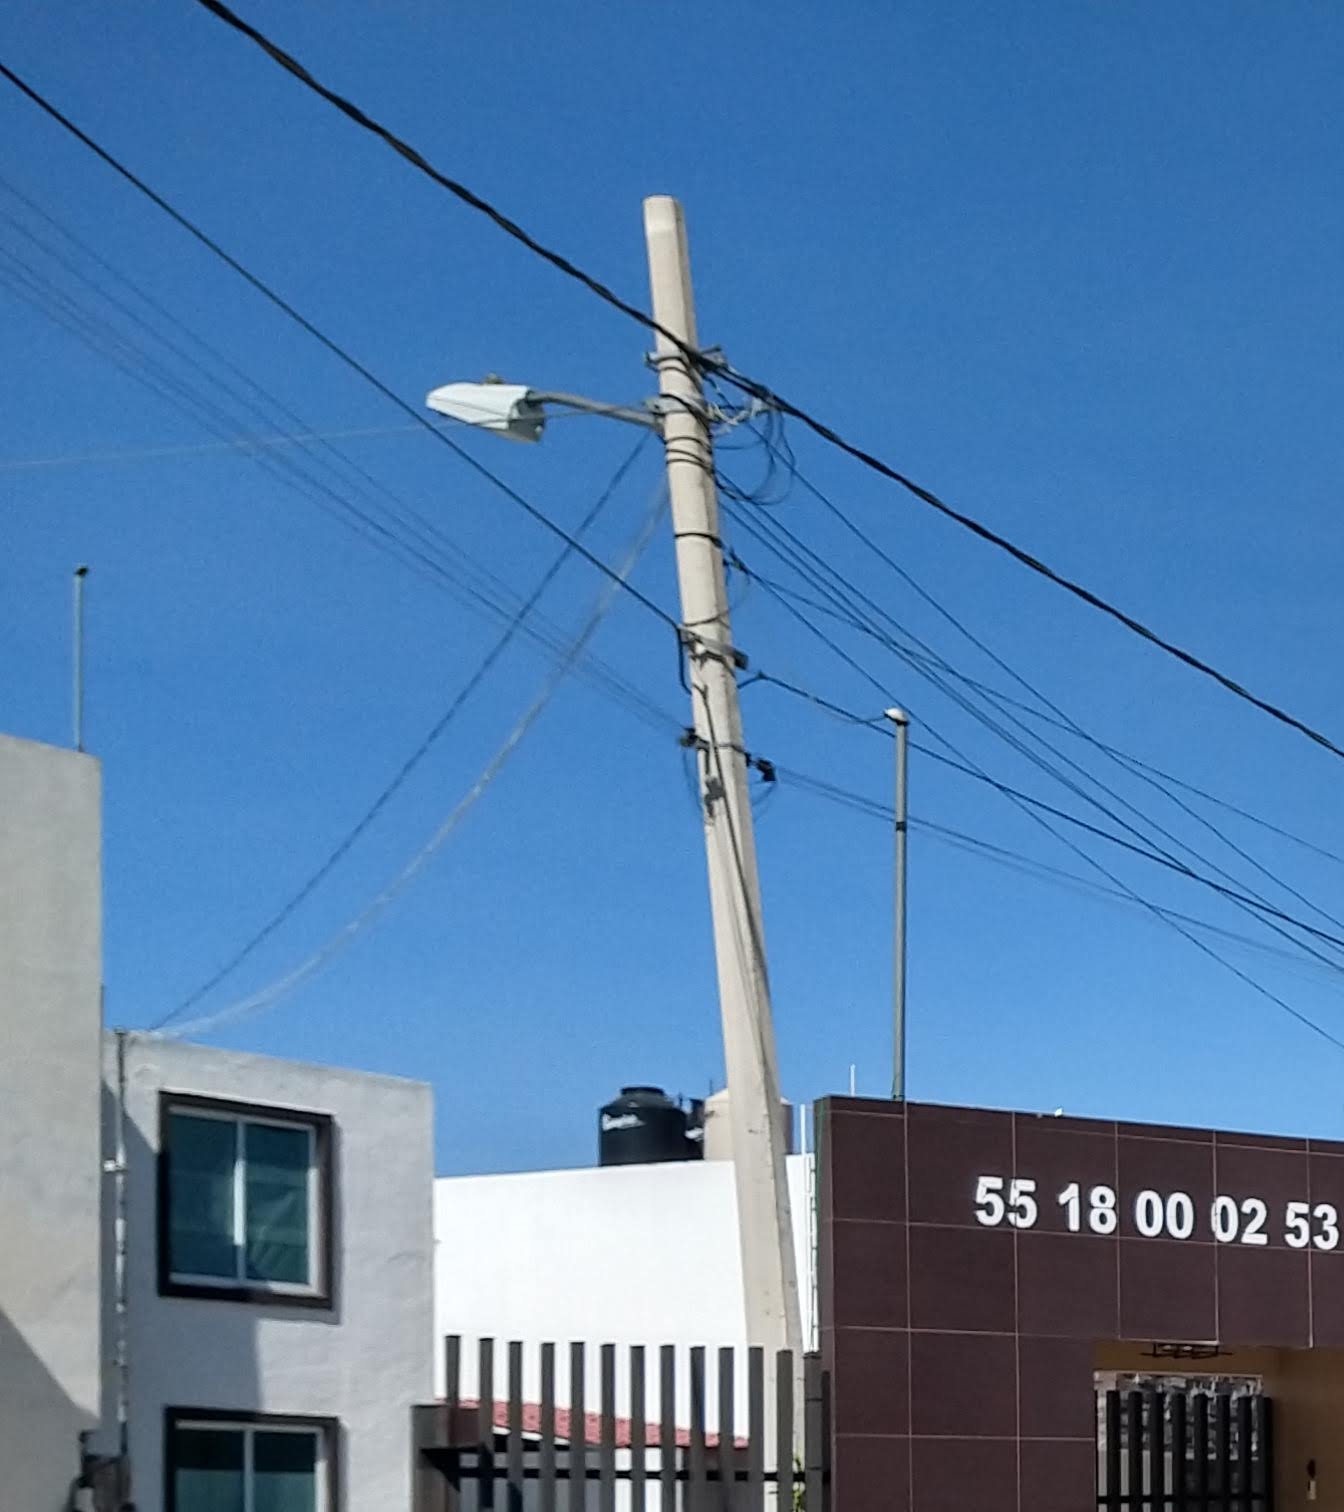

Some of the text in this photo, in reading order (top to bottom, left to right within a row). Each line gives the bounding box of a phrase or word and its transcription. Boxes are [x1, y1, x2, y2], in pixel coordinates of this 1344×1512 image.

[974, 1175, 1341, 1251] 55 18 00 02 53
